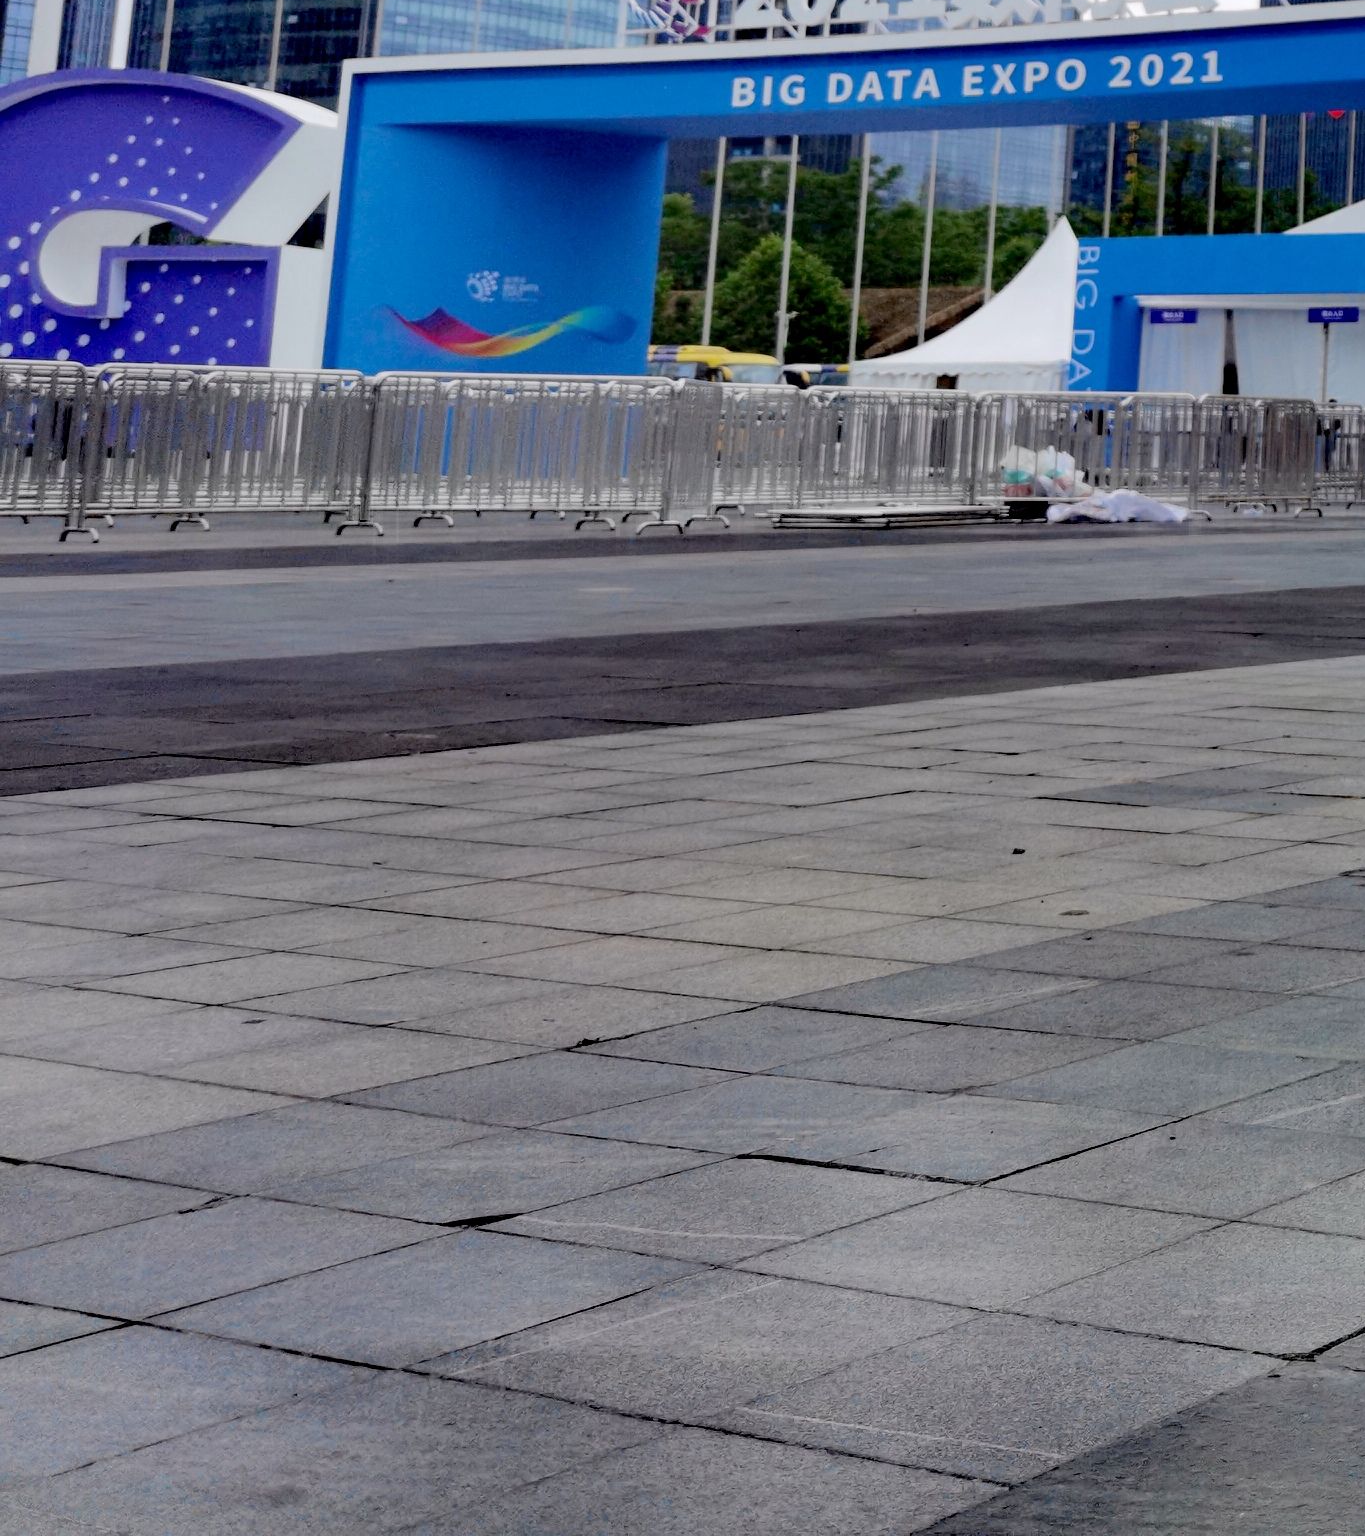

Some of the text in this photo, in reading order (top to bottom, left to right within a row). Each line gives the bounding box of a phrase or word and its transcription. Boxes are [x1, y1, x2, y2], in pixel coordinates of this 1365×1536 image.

[731, 50, 1224, 108] BIG DATA EXPO 2021
[1068, 246, 1100, 392] BIG DA
